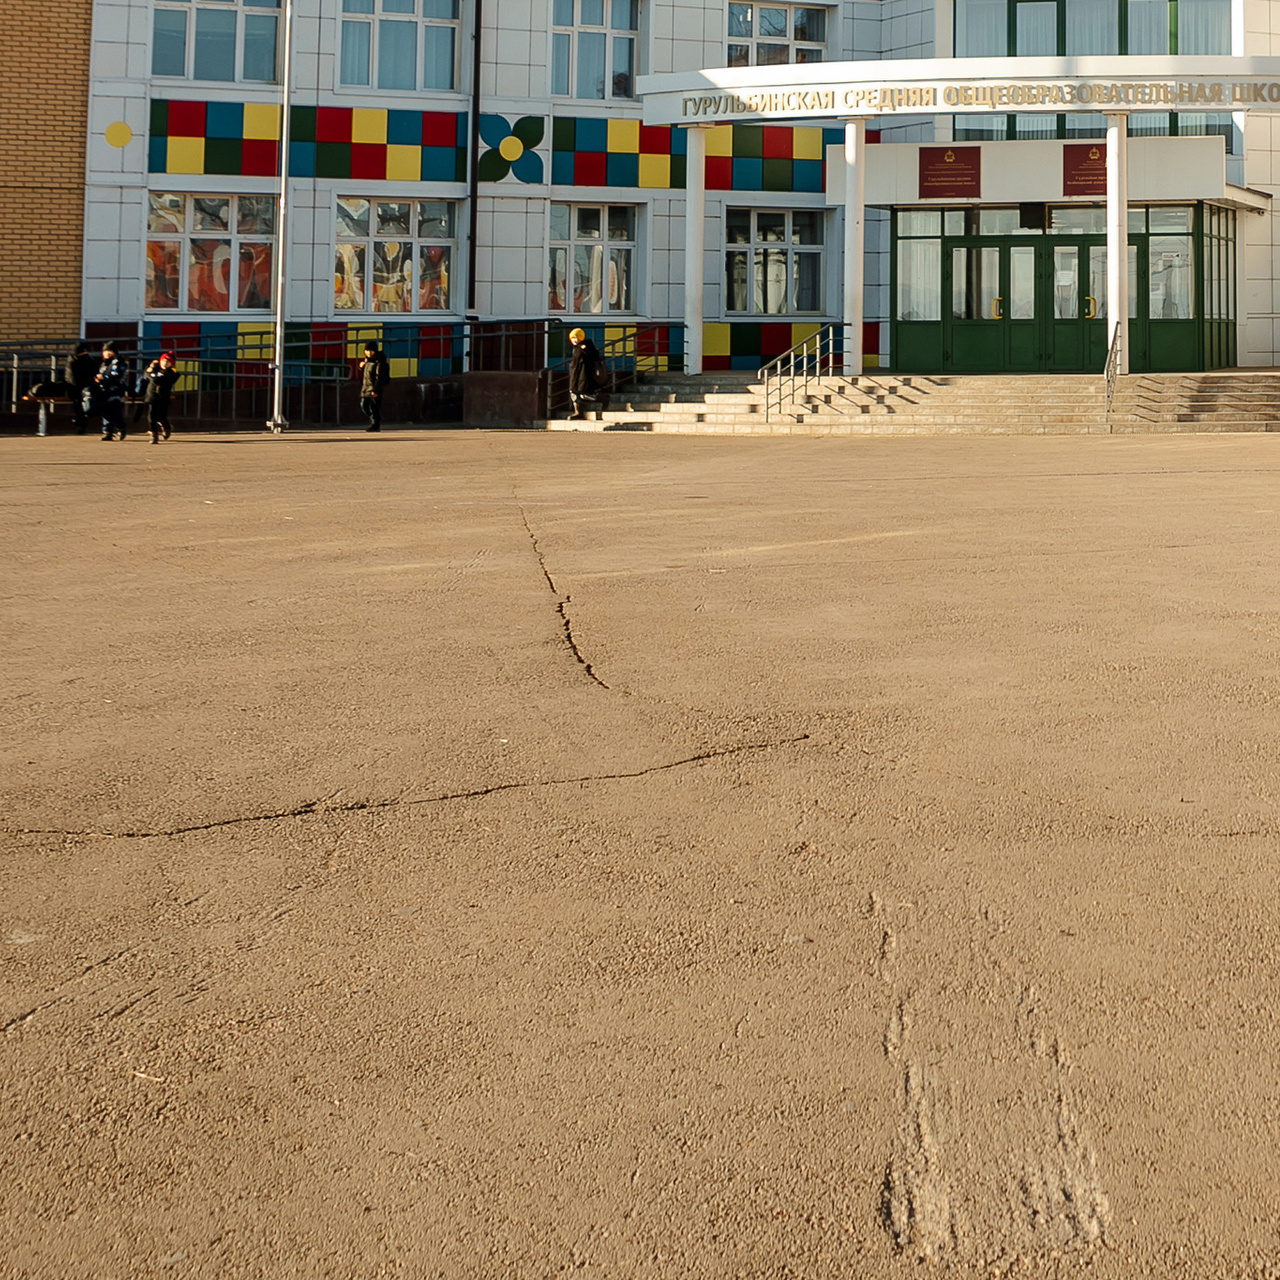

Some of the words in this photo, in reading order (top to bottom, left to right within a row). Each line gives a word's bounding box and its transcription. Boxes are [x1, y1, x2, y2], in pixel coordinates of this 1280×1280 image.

[681, 90, 836, 117] ГУРУЛЬБИНСКАЯ
[843, 86, 938, 111] СРЕДНЯЯ
[942, 82, 1223, 109] ОБЩЕОБРАЗОВАТЕЛЬНАЯ
